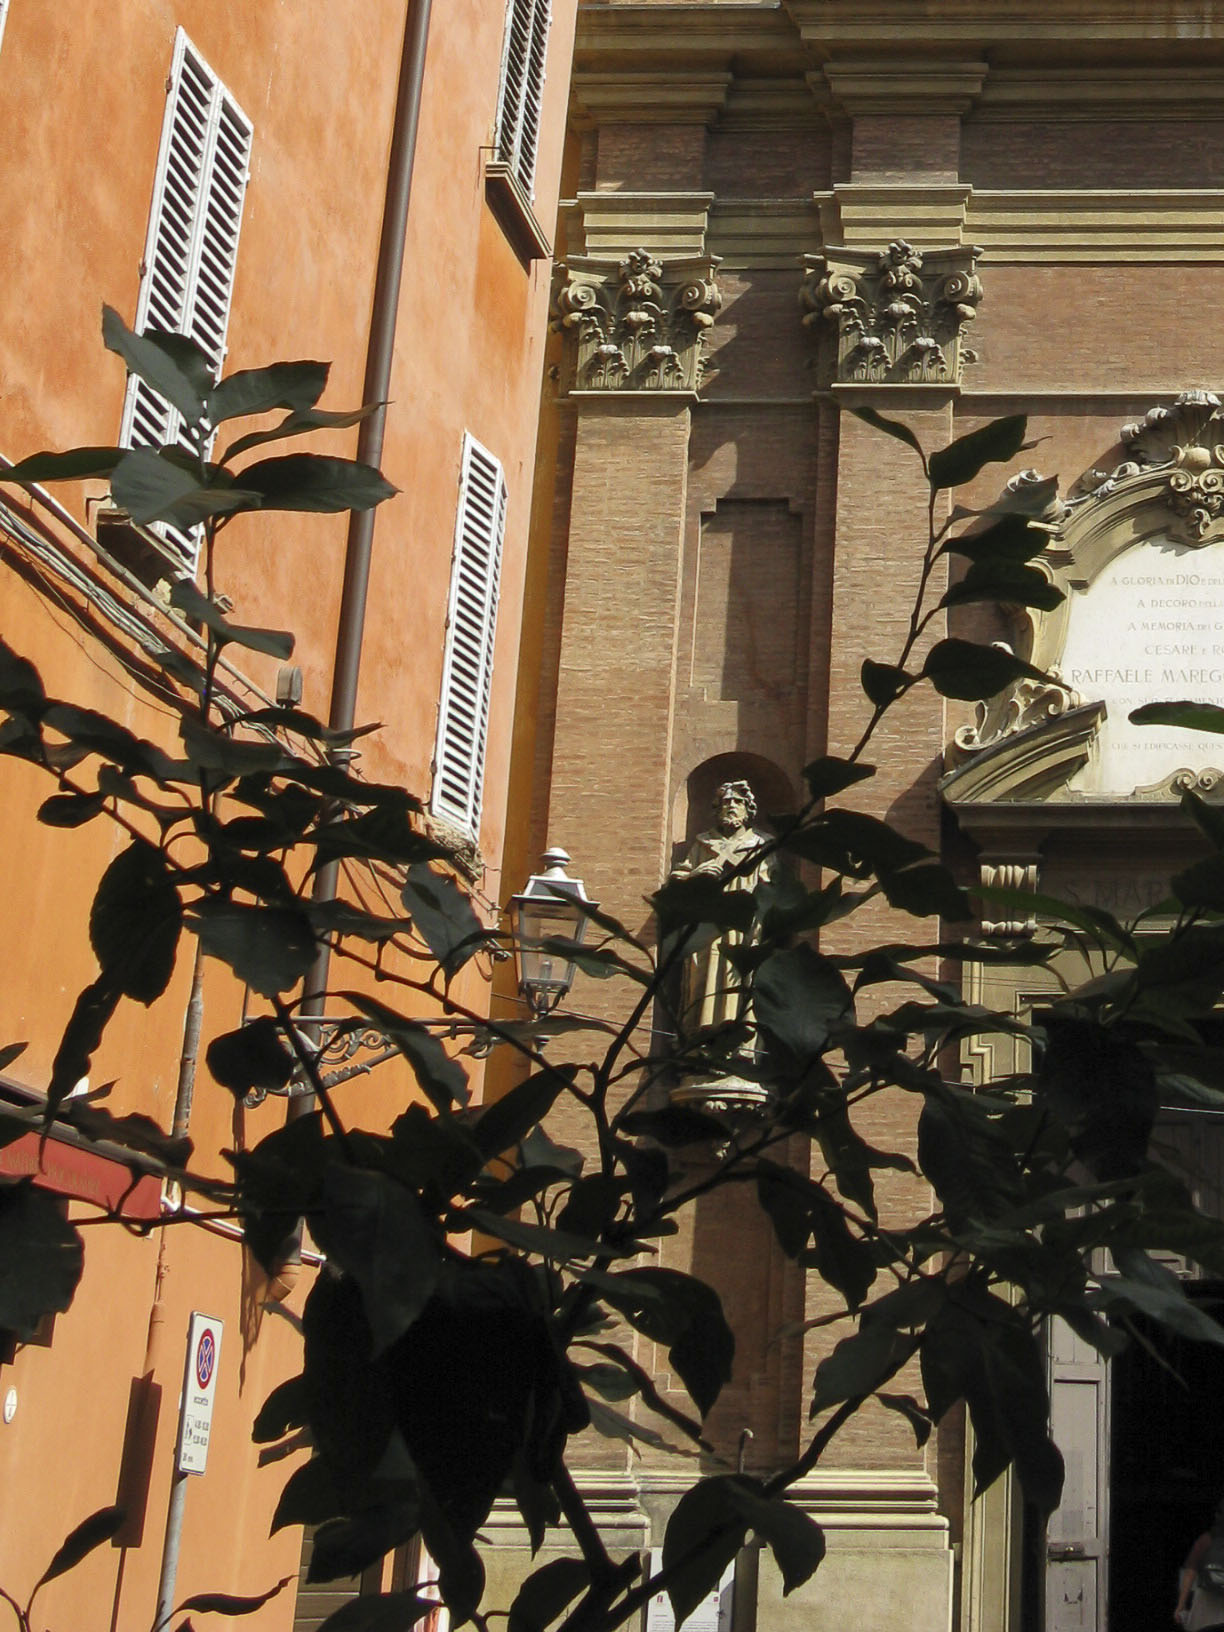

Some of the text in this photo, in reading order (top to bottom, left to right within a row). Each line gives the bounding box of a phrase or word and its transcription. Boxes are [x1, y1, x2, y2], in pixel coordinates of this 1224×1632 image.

[1120, 576, 1164, 586] GLORIA
[1175, 573, 1200, 586] DIO
[1136, 599, 1145, 608] A
[1150, 599, 1197, 608] DECORO
[1127, 622, 1137, 631] A
[1141, 622, 1195, 631] MEMORIA
[1144, 644, 1198, 655] CESARE
[1071, 669, 1153, 684] RAFFAELE
